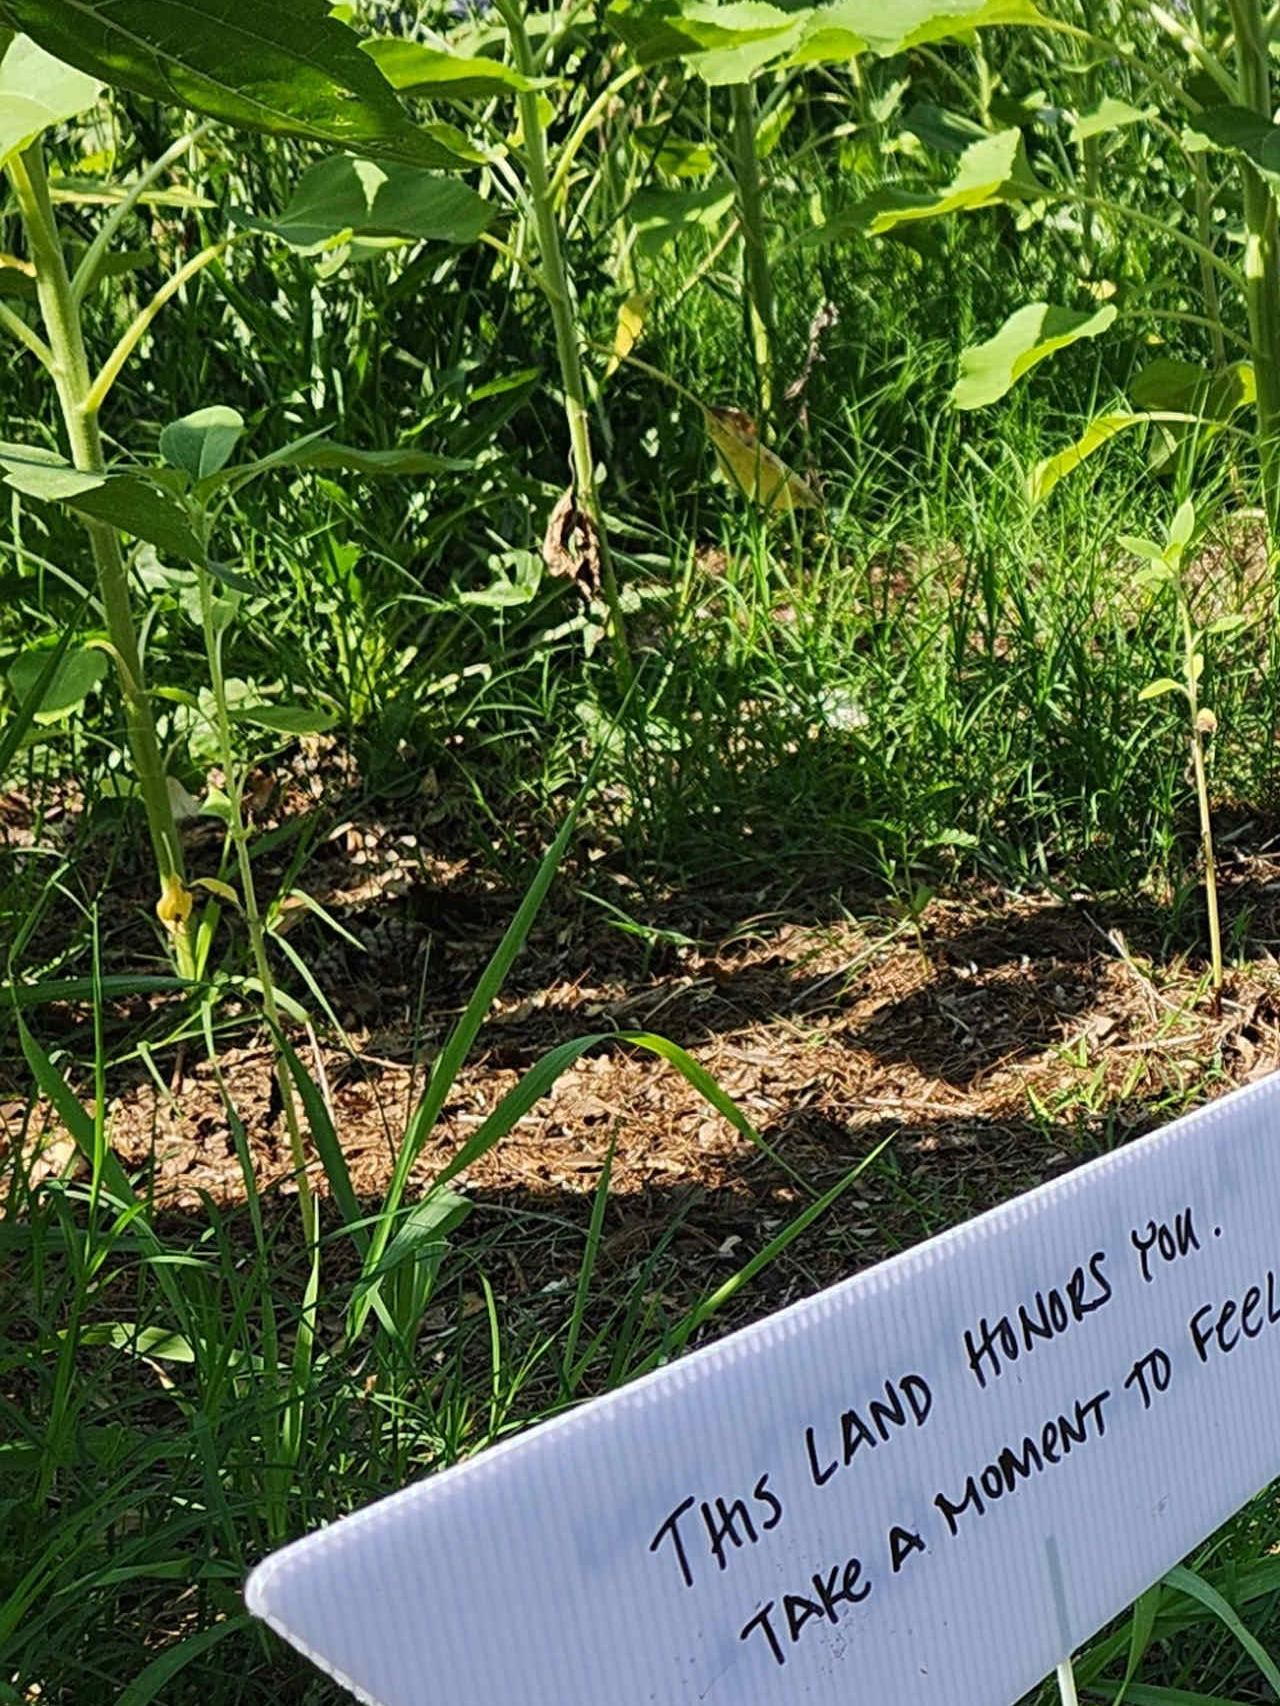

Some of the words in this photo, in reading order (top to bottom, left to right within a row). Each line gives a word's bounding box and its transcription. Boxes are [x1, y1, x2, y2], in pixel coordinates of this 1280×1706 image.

[806, 1375, 932, 1486] LAND
[964, 1251, 1112, 1389] HONORS
[1131, 1207, 1221, 1282] YOU.
[890, 1526, 926, 1573] A
[1124, 1348, 1171, 1410] TO
